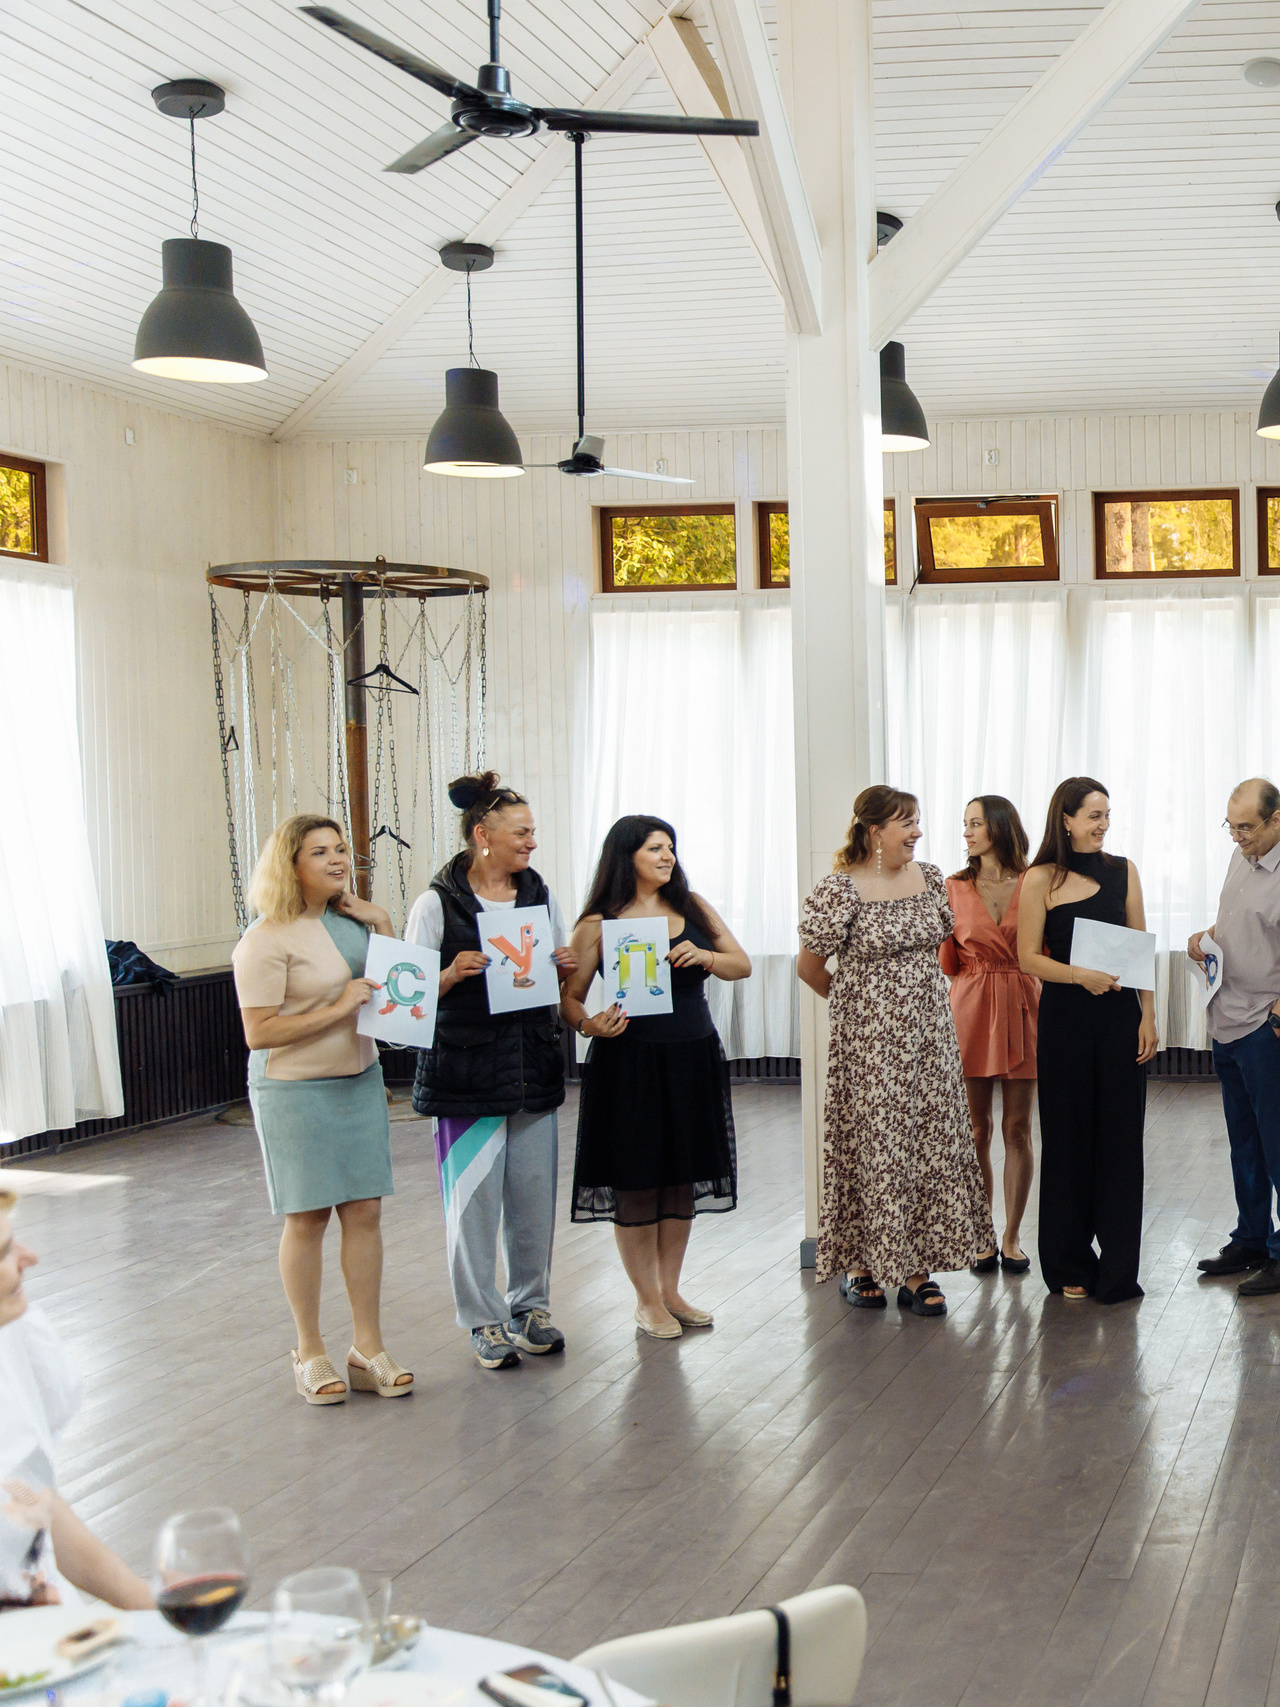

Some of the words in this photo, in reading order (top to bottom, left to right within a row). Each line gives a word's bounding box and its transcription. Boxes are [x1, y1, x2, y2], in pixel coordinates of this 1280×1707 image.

[488, 922, 534, 980] У
[618, 942, 657, 990] П
[387, 962, 426, 1006] С
